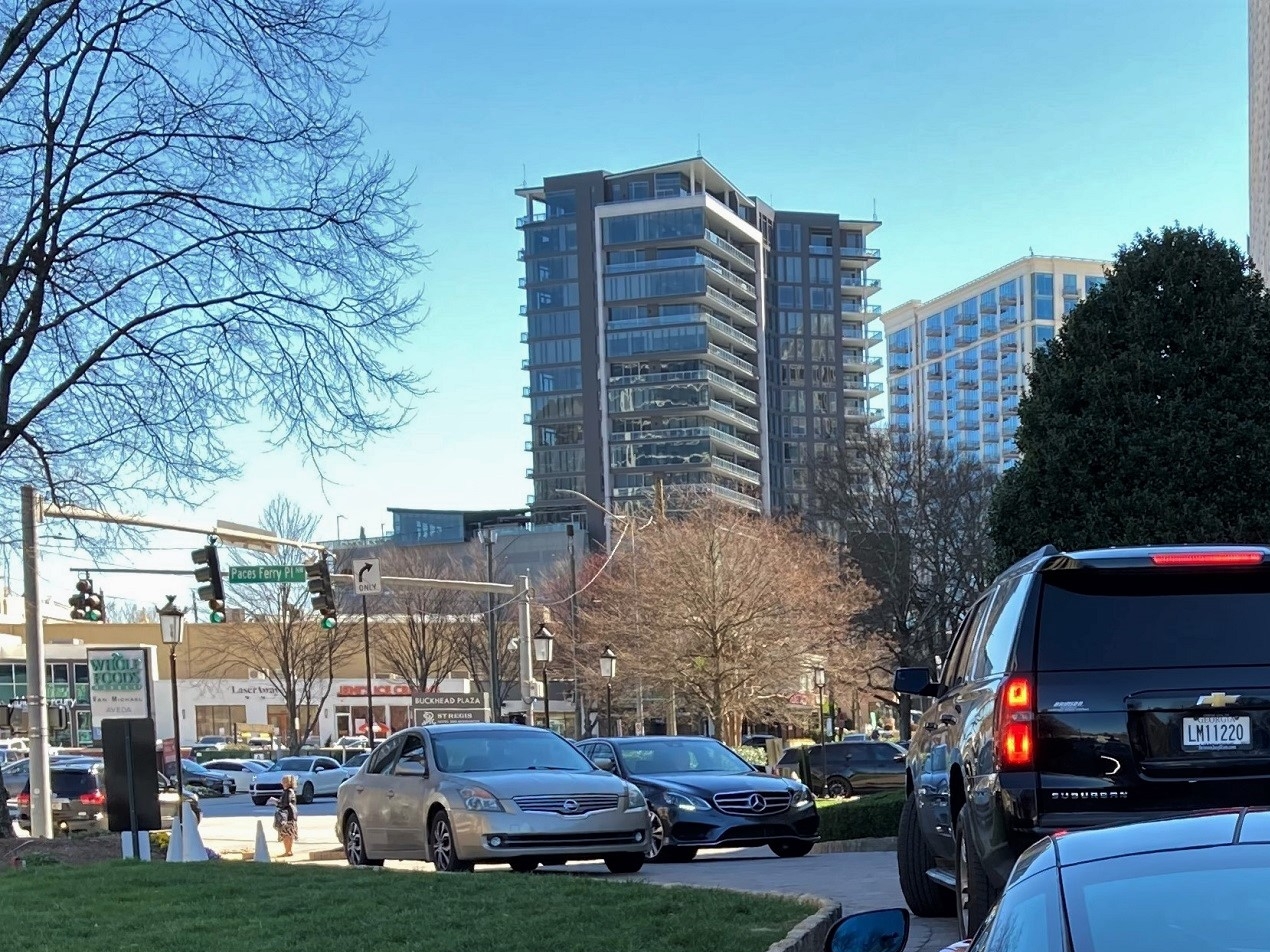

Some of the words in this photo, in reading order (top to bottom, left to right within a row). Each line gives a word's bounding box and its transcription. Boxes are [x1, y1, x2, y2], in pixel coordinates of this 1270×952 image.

[231, 568, 256, 579] Paces
[259, 567, 281, 581] Ferry
[284, 567, 294, 578] Pl
[90, 660, 141, 671] WHOLE
[93, 672, 141, 684] FOODS
[1188, 724, 1244, 742] LM11220
